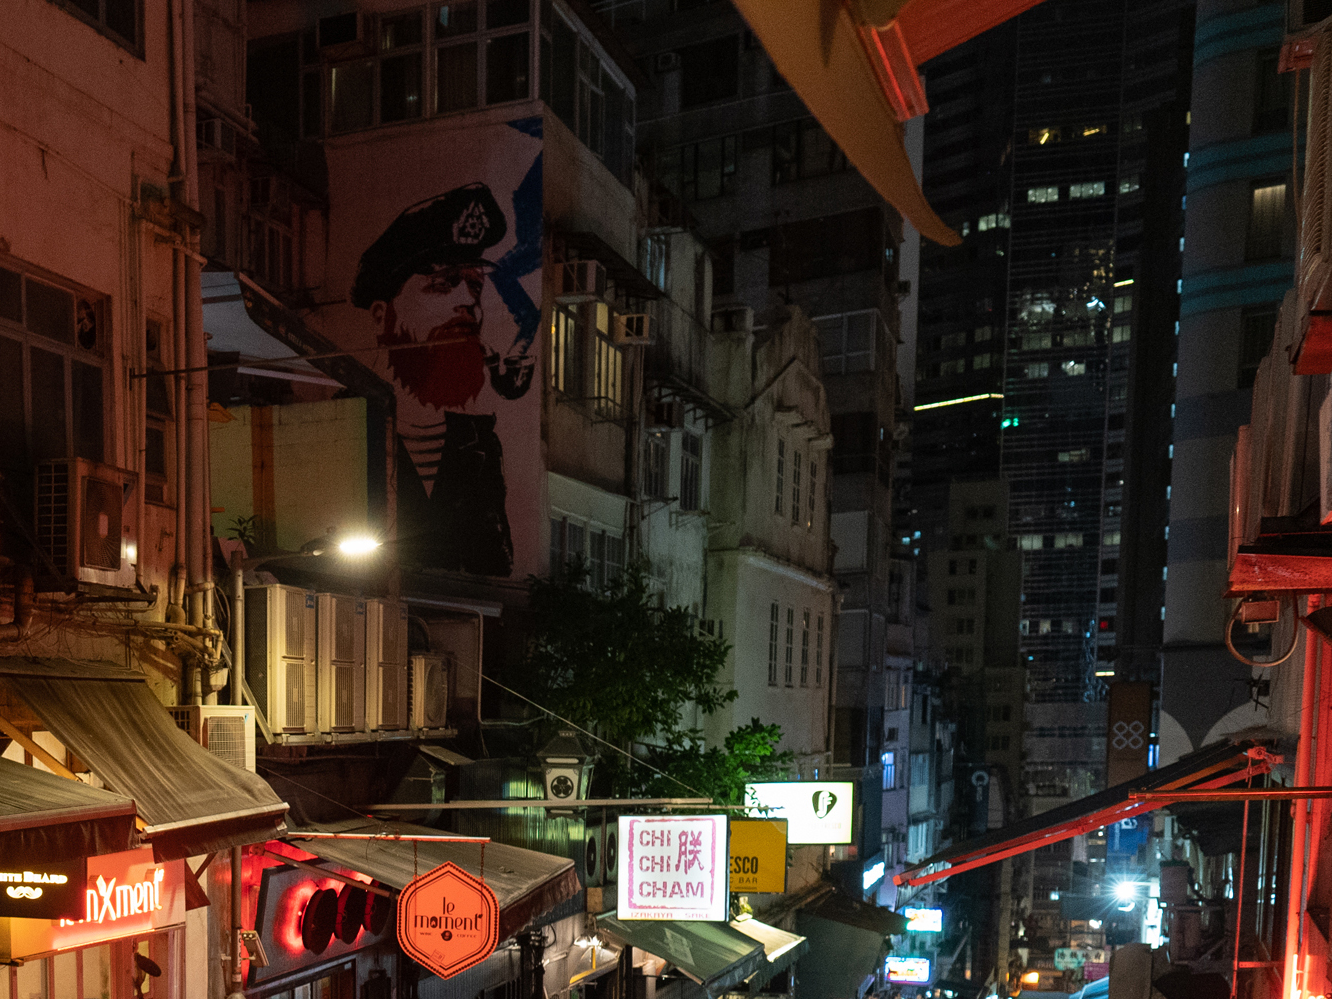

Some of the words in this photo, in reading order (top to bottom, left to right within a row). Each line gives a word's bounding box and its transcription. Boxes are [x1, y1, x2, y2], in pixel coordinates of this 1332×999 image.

[639, 829, 672, 847] CHI
[639, 855, 672, 873] CHI
[638, 881, 705, 898] CHAM
[442, 896, 455, 916] le
[414, 913, 483, 931] moment
